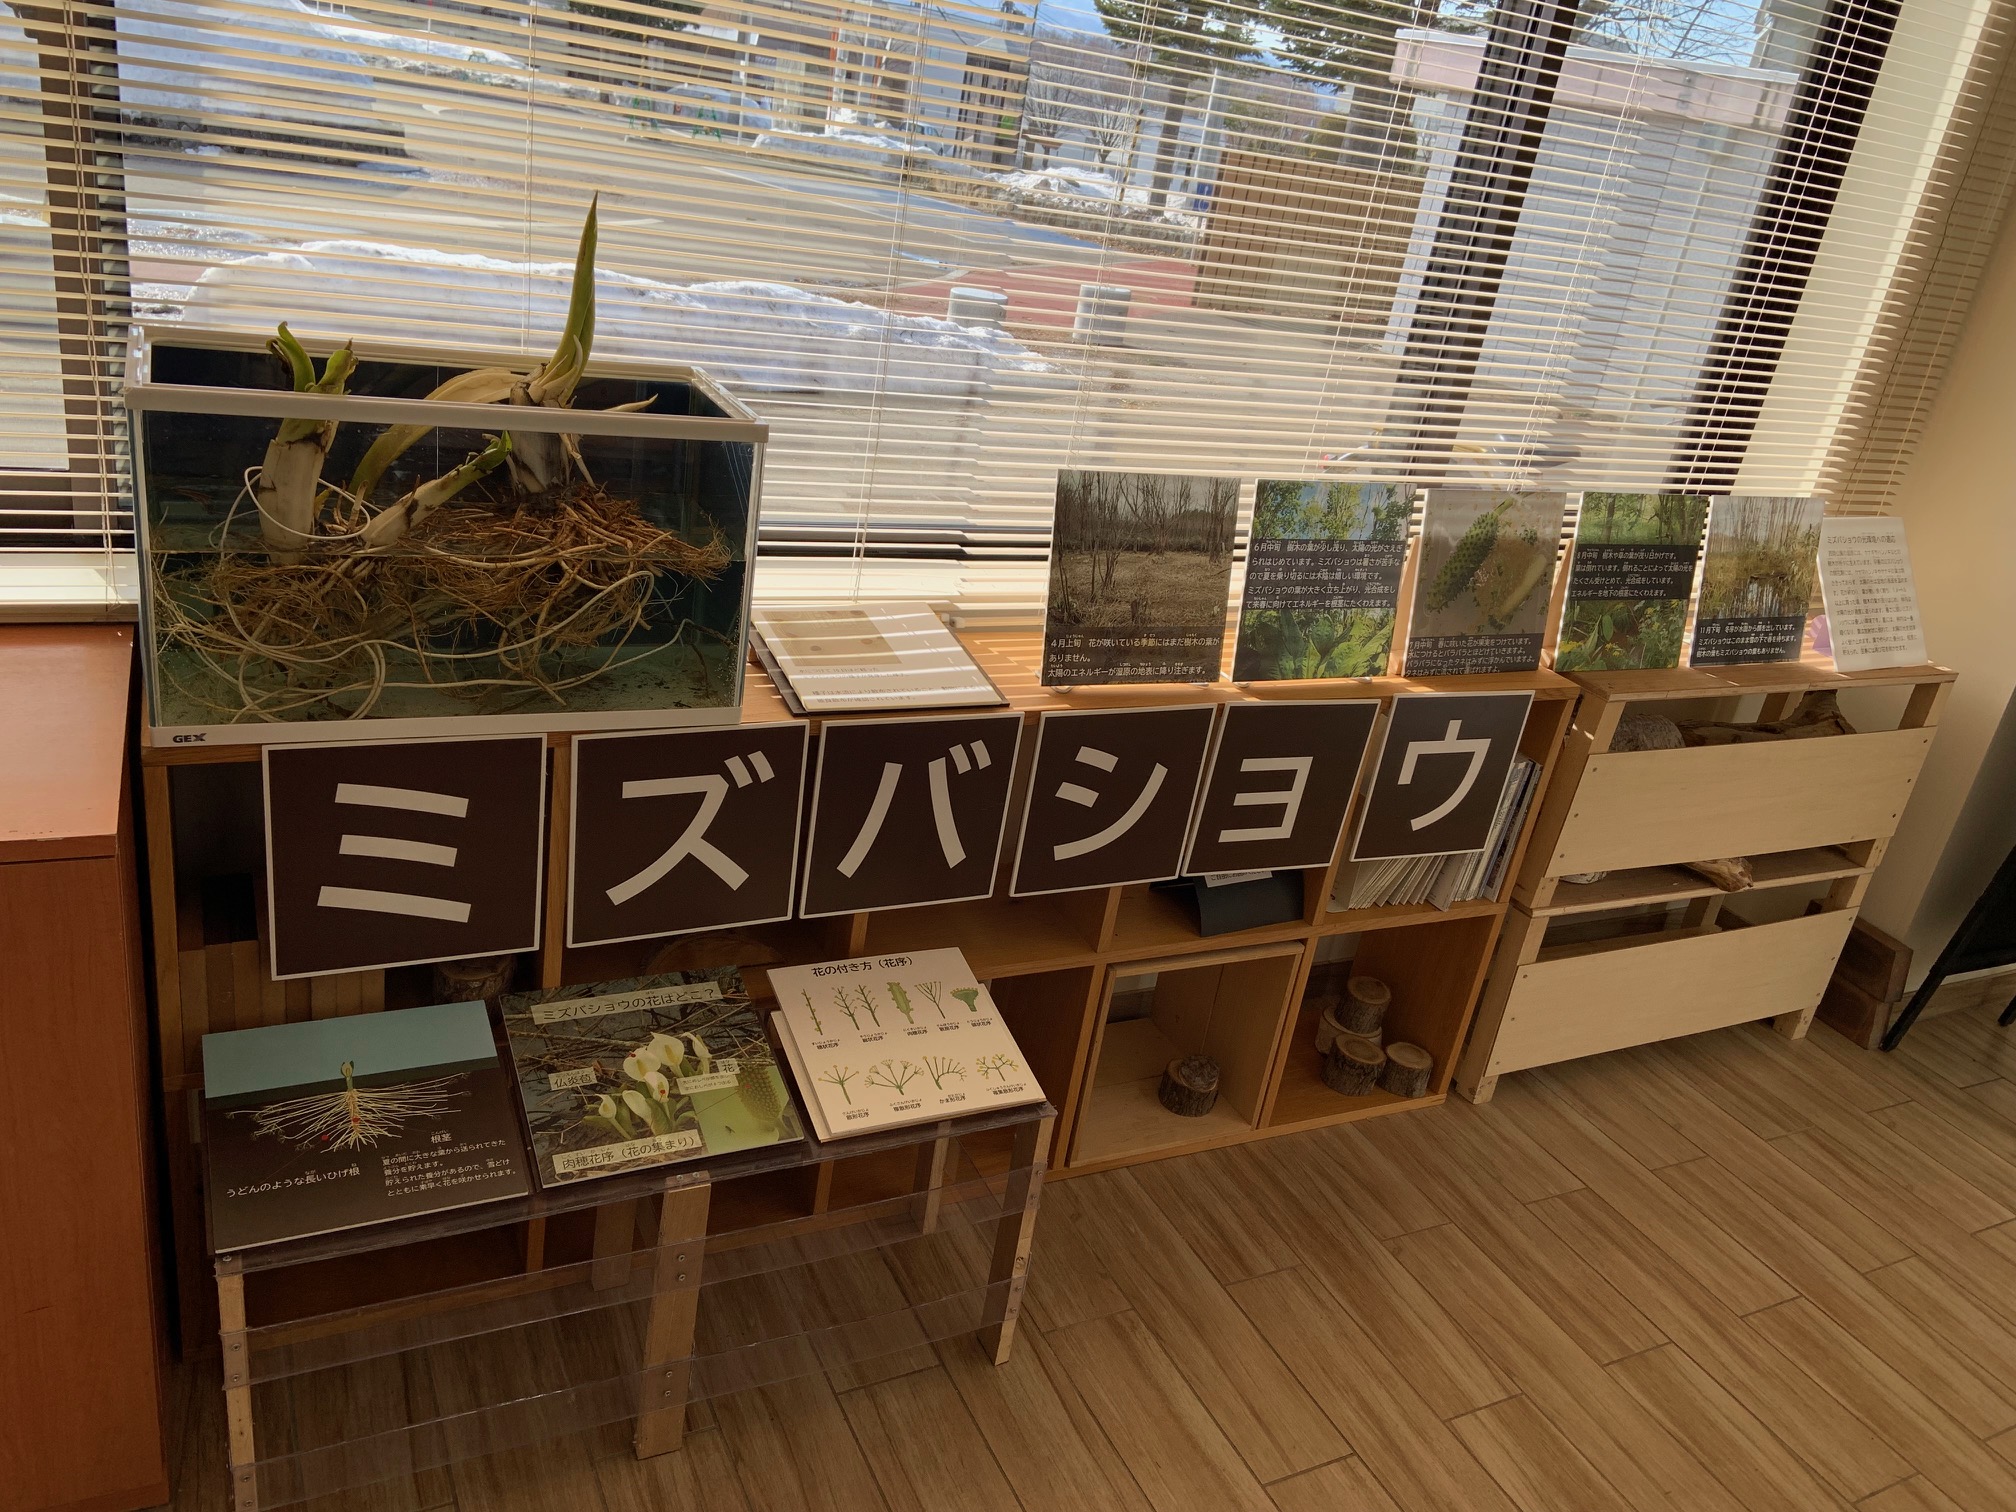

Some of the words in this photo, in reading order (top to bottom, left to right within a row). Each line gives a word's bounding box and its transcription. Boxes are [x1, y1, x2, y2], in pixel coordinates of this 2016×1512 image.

[1050, 638, 1082, 648] 4月上旬
[1048, 654, 1091, 663] ありません。
[172, 732, 207, 744] GEX
[811, 955, 914, 978] 花の付き方（花序）
[543, 988, 715, 1021] ミズバショウの花はどこ？
[721, 1063, 735, 1073] 花
[430, 1132, 453, 1144] 根茎
[562, 1136, 695, 1170] 肉穂花序（花の集まり）
[226, 1166, 361, 1198] うどんのような長いひげ根
